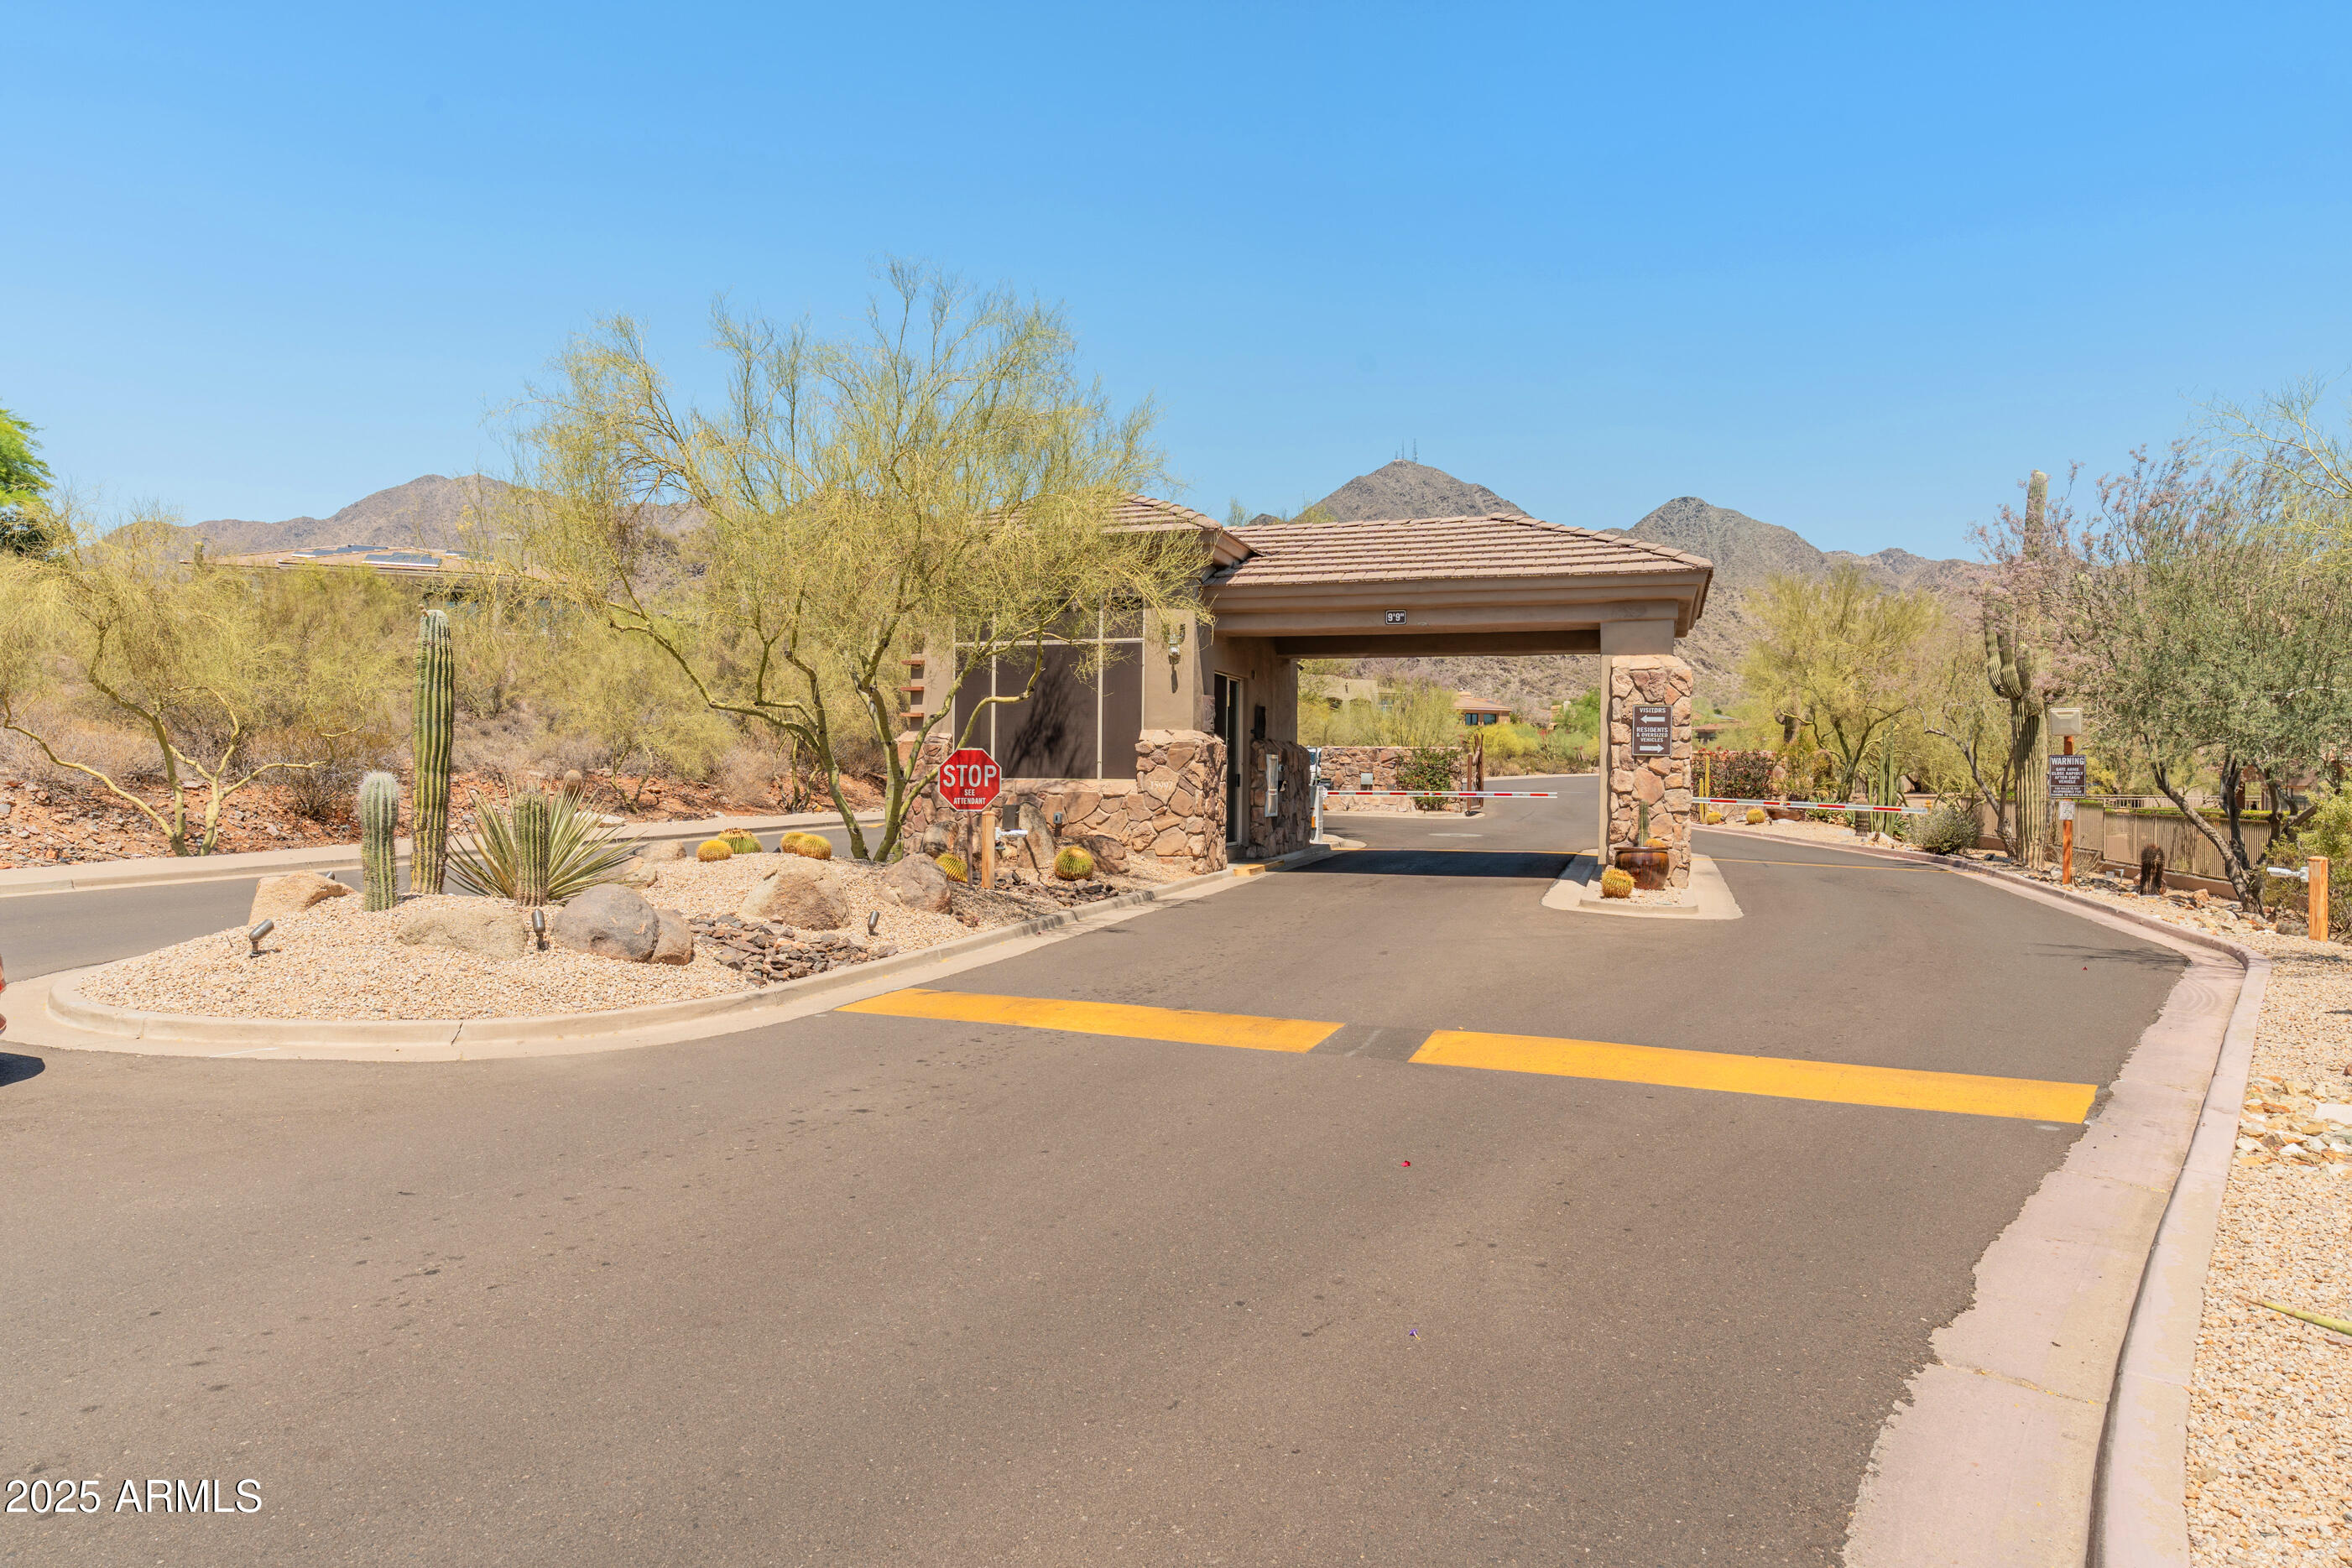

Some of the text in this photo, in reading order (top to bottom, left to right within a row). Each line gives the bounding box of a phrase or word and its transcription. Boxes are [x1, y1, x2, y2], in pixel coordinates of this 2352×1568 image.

[2051, 757, 2084, 765] WARNING
[942, 763, 997, 787] STOP
[1150, 780, 1173, 791] 15997
